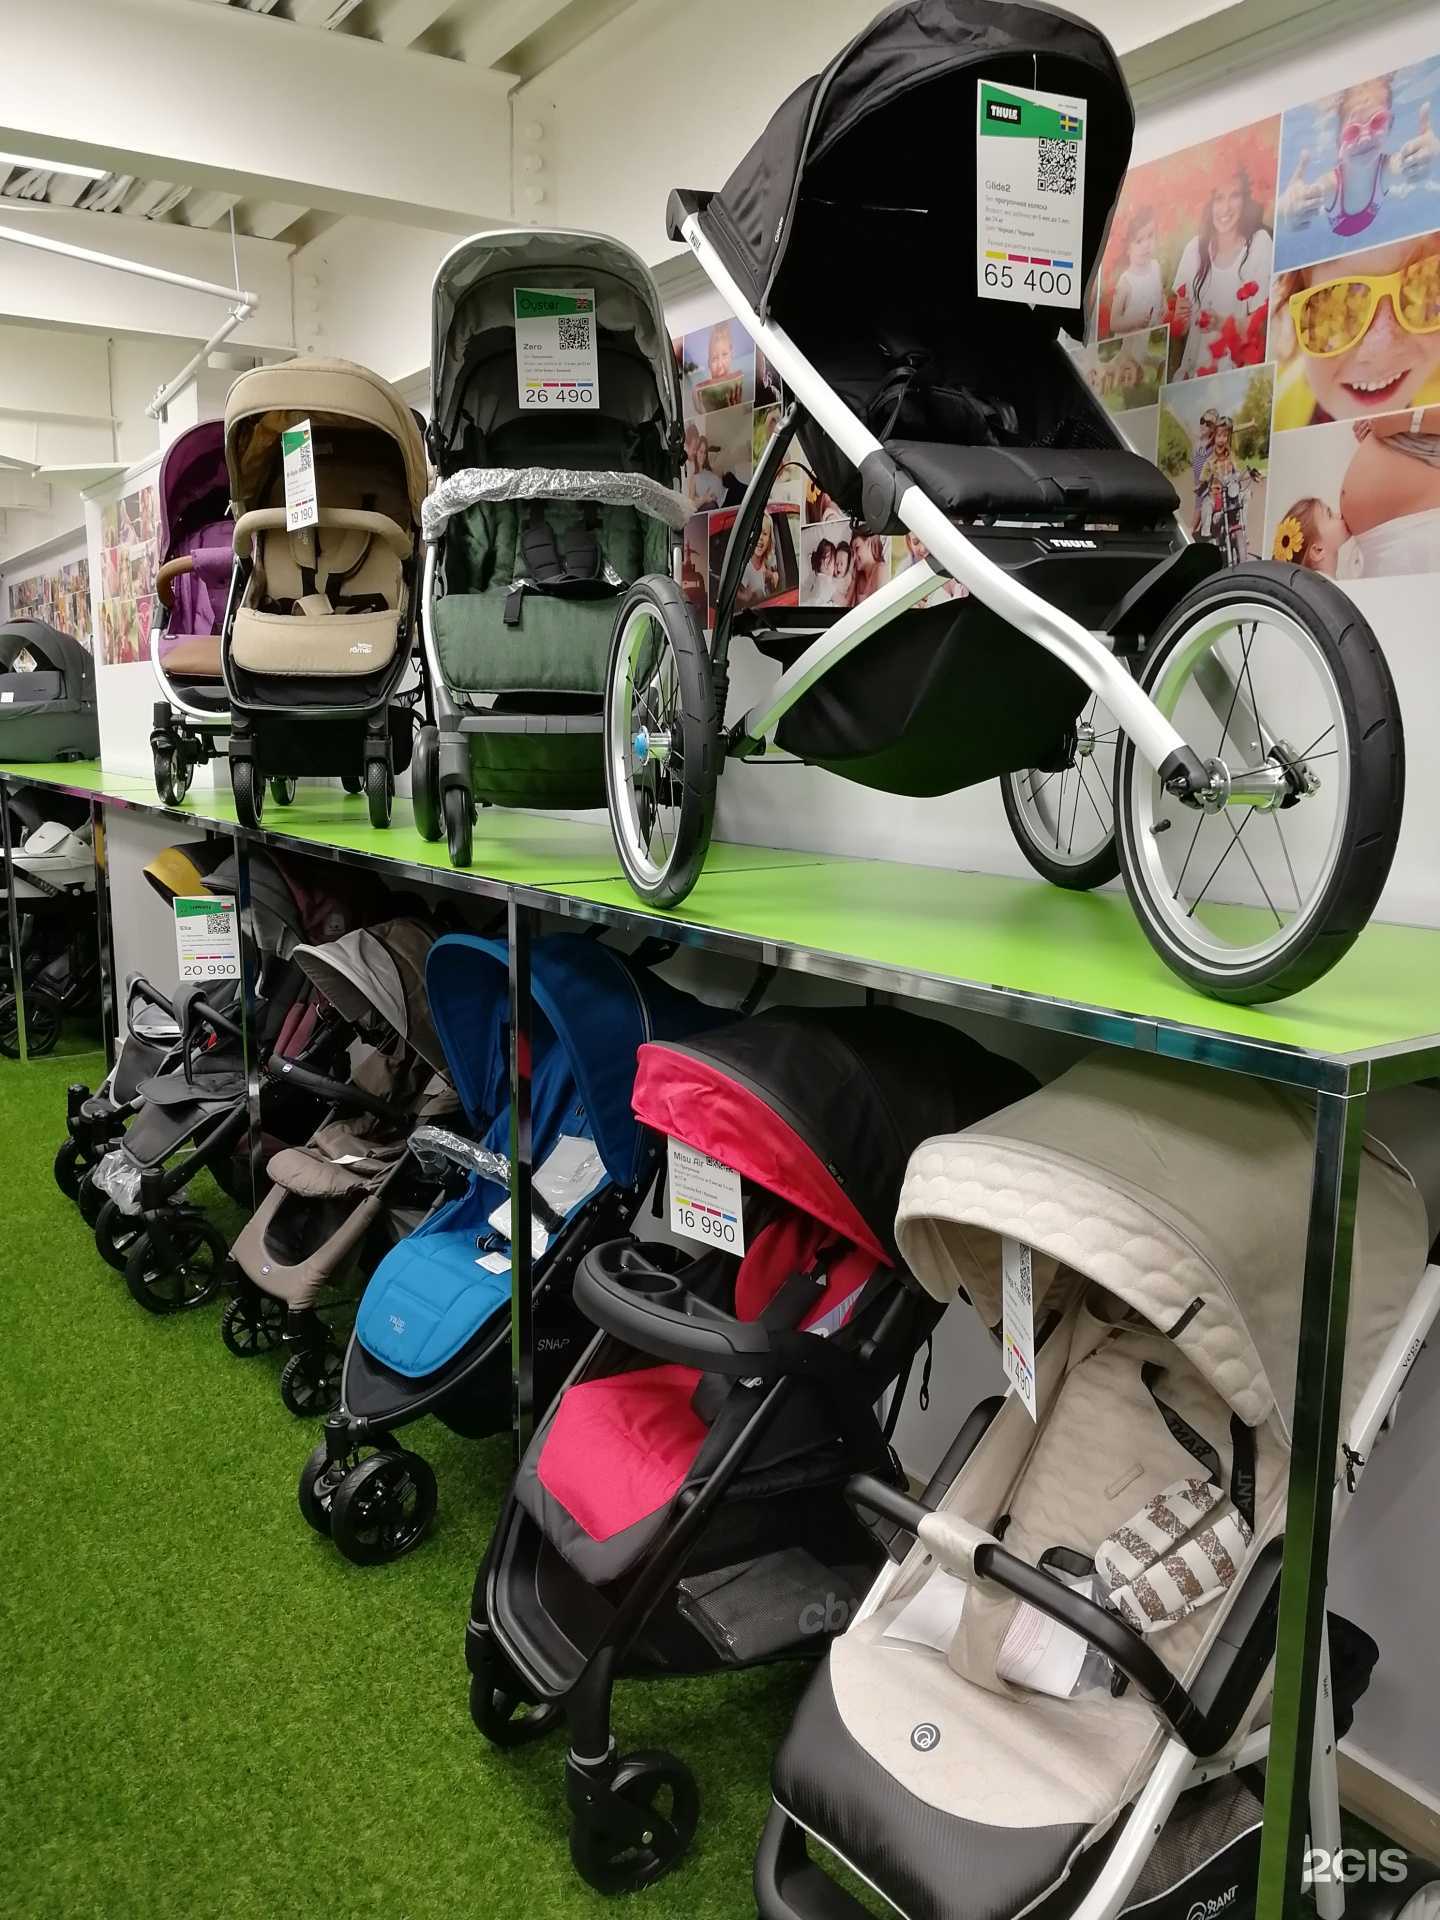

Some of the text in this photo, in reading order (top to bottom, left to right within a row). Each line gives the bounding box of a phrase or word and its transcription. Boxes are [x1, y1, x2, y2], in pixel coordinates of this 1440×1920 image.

[990, 104, 1018, 121] THULE
[984, 263, 1072, 296] 65 400
[520, 299, 560, 312] Oyster
[522, 343, 543, 351] Zero
[526, 389, 592, 403] 26 490
[301, 506, 314, 521] 190
[1050, 539, 1097, 549] THULE
[184, 964, 237, 976] 20 990
[673, 1151, 692, 1165] Misu
[693, 1157, 705, 1168] Air
[678, 1207, 736, 1243] 16 990
[537, 1338, 571, 1351] SNAP
[1014, 1361, 1032, 1399] 490
[1237, 1470, 1253, 1512] ANT
[1207, 1884, 1239, 1914] RANT
